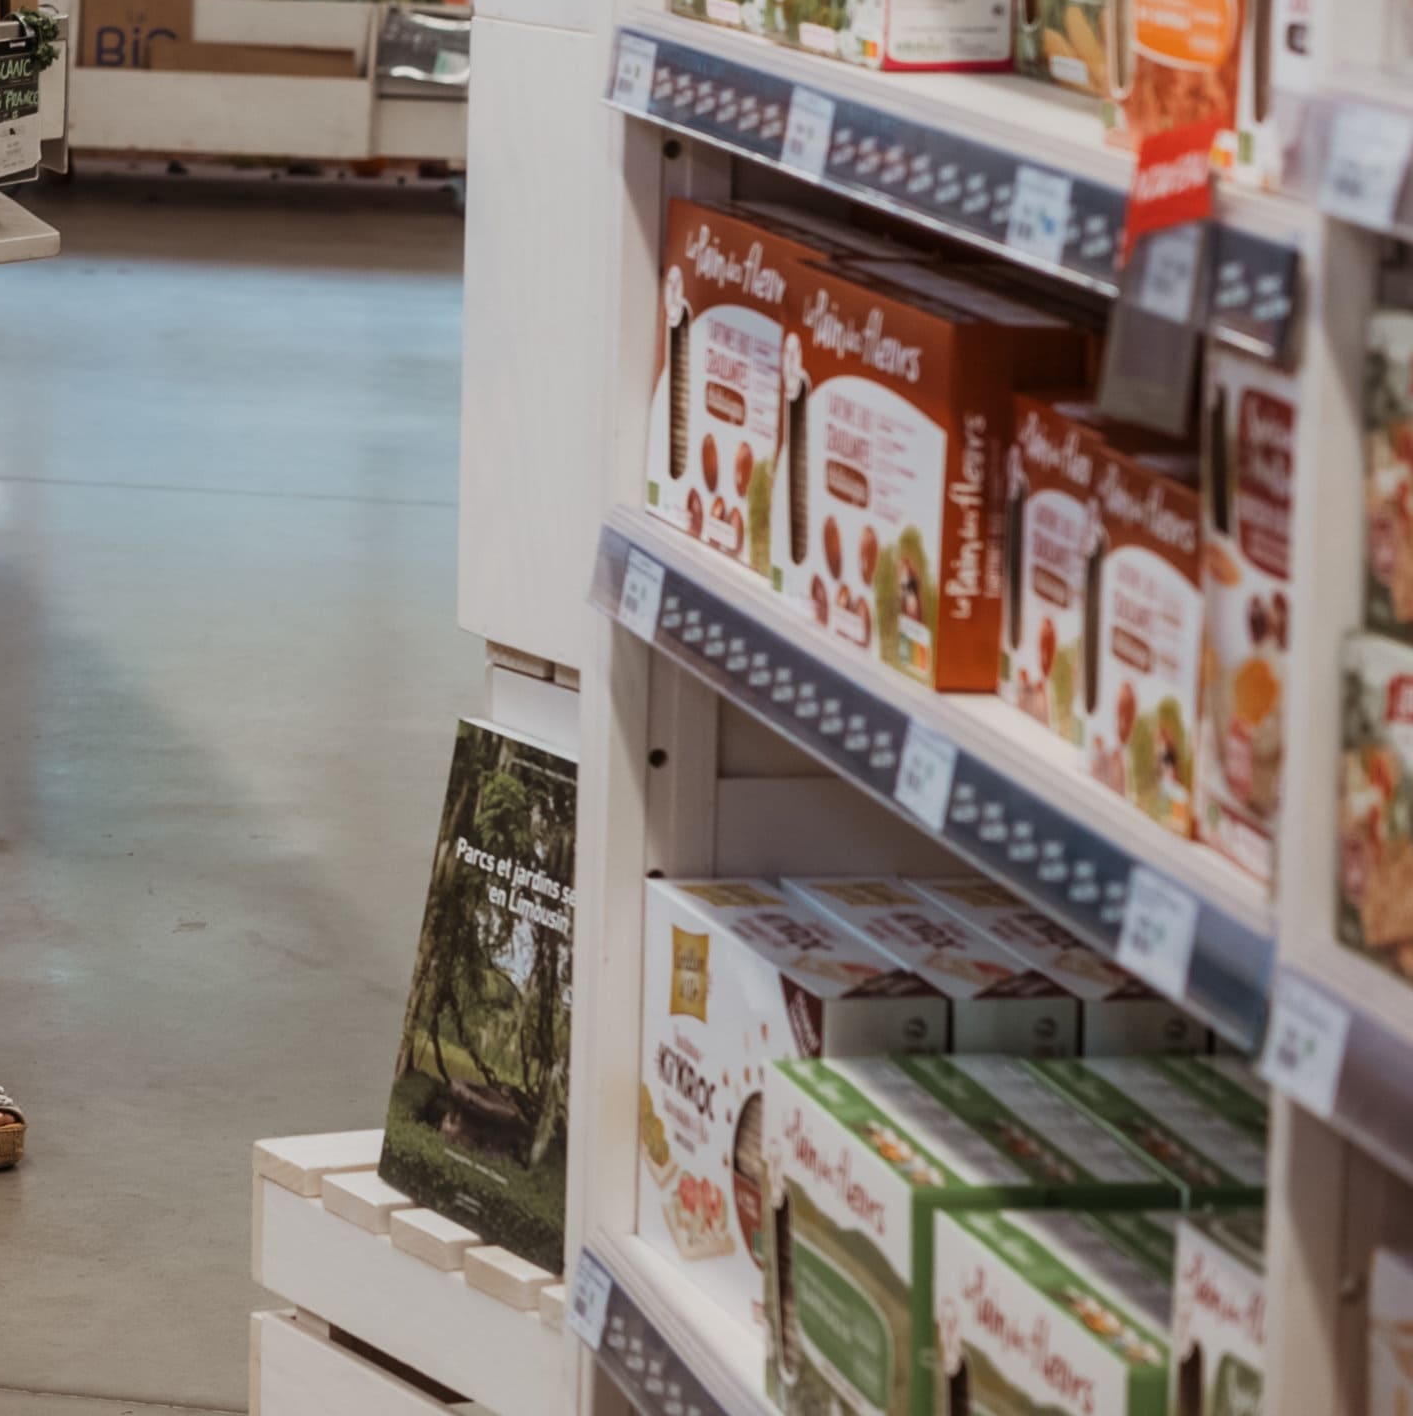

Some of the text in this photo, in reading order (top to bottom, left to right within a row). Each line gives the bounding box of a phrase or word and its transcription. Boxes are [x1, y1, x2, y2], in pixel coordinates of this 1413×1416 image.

[455, 836, 496, 874] Parcs
[496, 857, 512, 881] et
[511, 859, 561, 901] jardins
[488, 884, 570, 936] en Limousin
